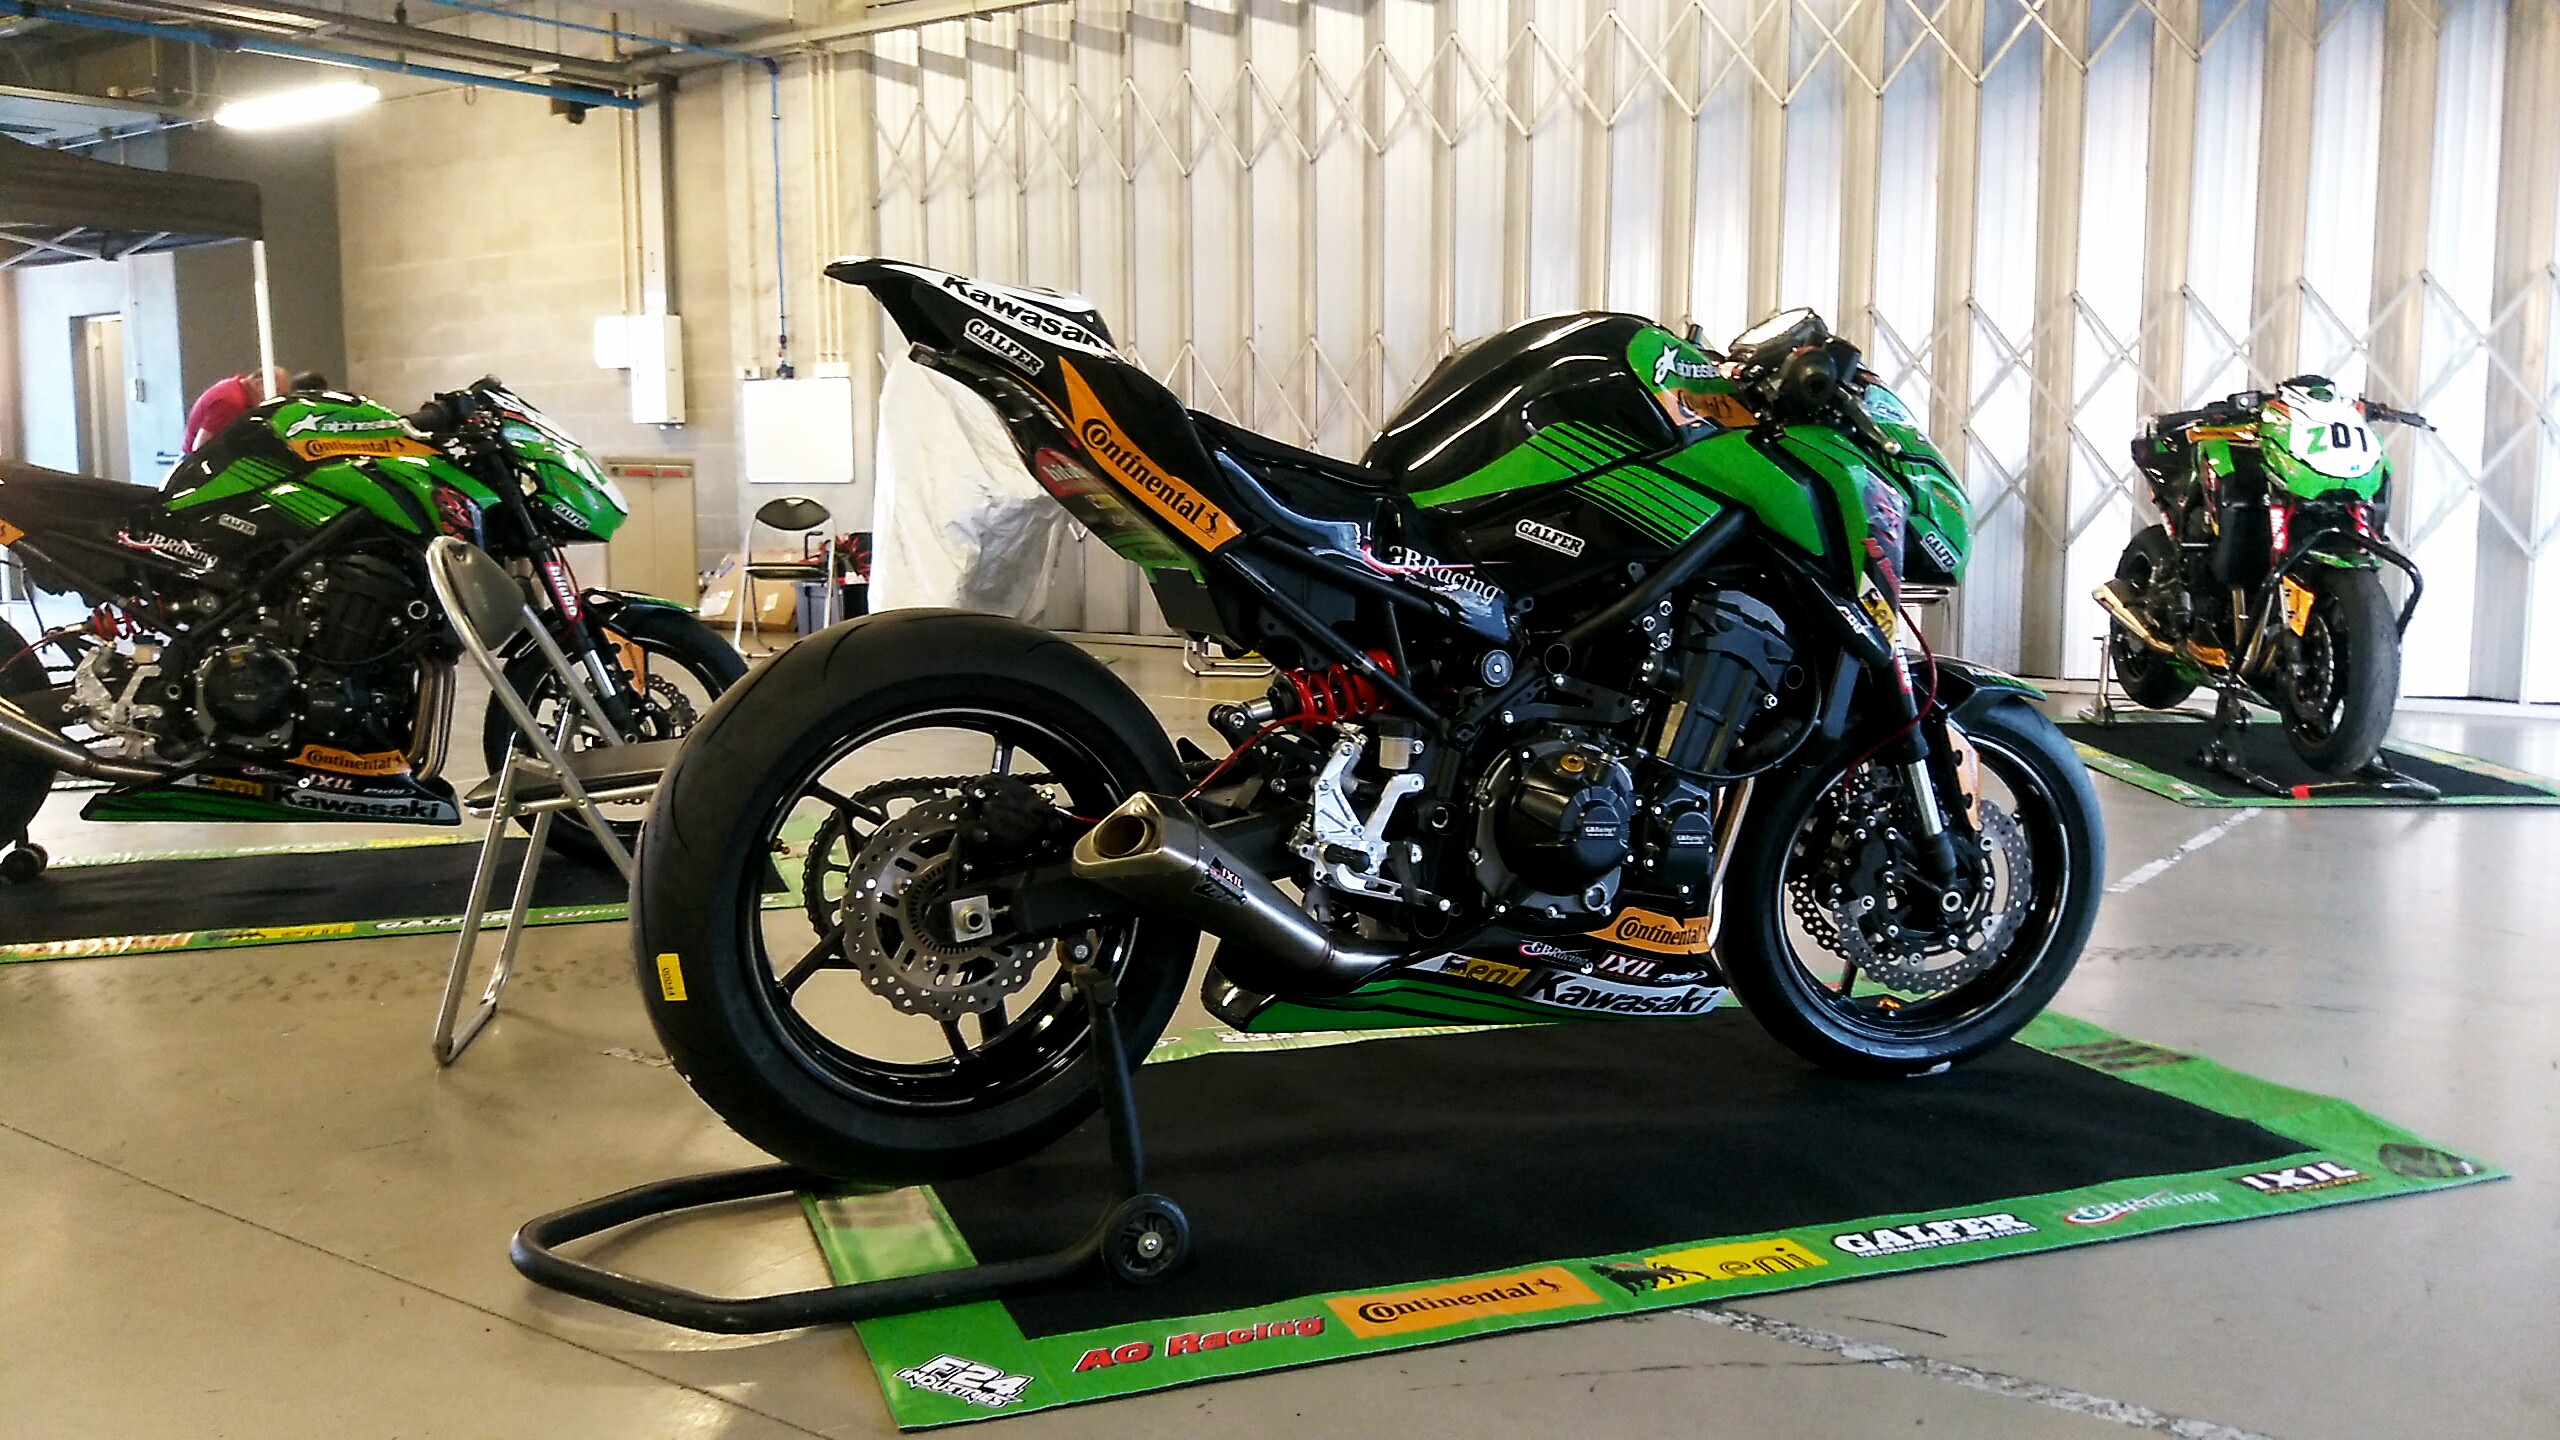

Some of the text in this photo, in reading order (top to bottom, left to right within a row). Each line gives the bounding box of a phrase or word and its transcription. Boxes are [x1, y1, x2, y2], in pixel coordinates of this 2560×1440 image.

[967, 319, 1043, 372] GALFER
[306, 439, 392, 457] Continental
[1082, 418, 1206, 525] Continental
[554, 502, 591, 530] GALFER
[1517, 520, 1584, 553] GALFER
[549, 564, 579, 617] bitubo
[305, 750, 392, 770] Continental
[274, 784, 439, 818] Kawasaki
[1221, 867, 1244, 889] IXIL
[1615, 916, 1702, 946] Continental
[1597, 953, 1657, 978] IXIL
[1523, 974, 1720, 1013] Kawasaki
[2242, 1160, 2358, 1191] IXIL
[1833, 1213, 2030, 1253] GALFER
[1718, 1246, 1813, 1278] eni
[1357, 1281, 1535, 1324] Continental
[1071, 1315, 1326, 1373] AG Racing
[897, 1368, 1010, 1407] INDUSTRIES
[917, 1355, 1033, 1396] F24
